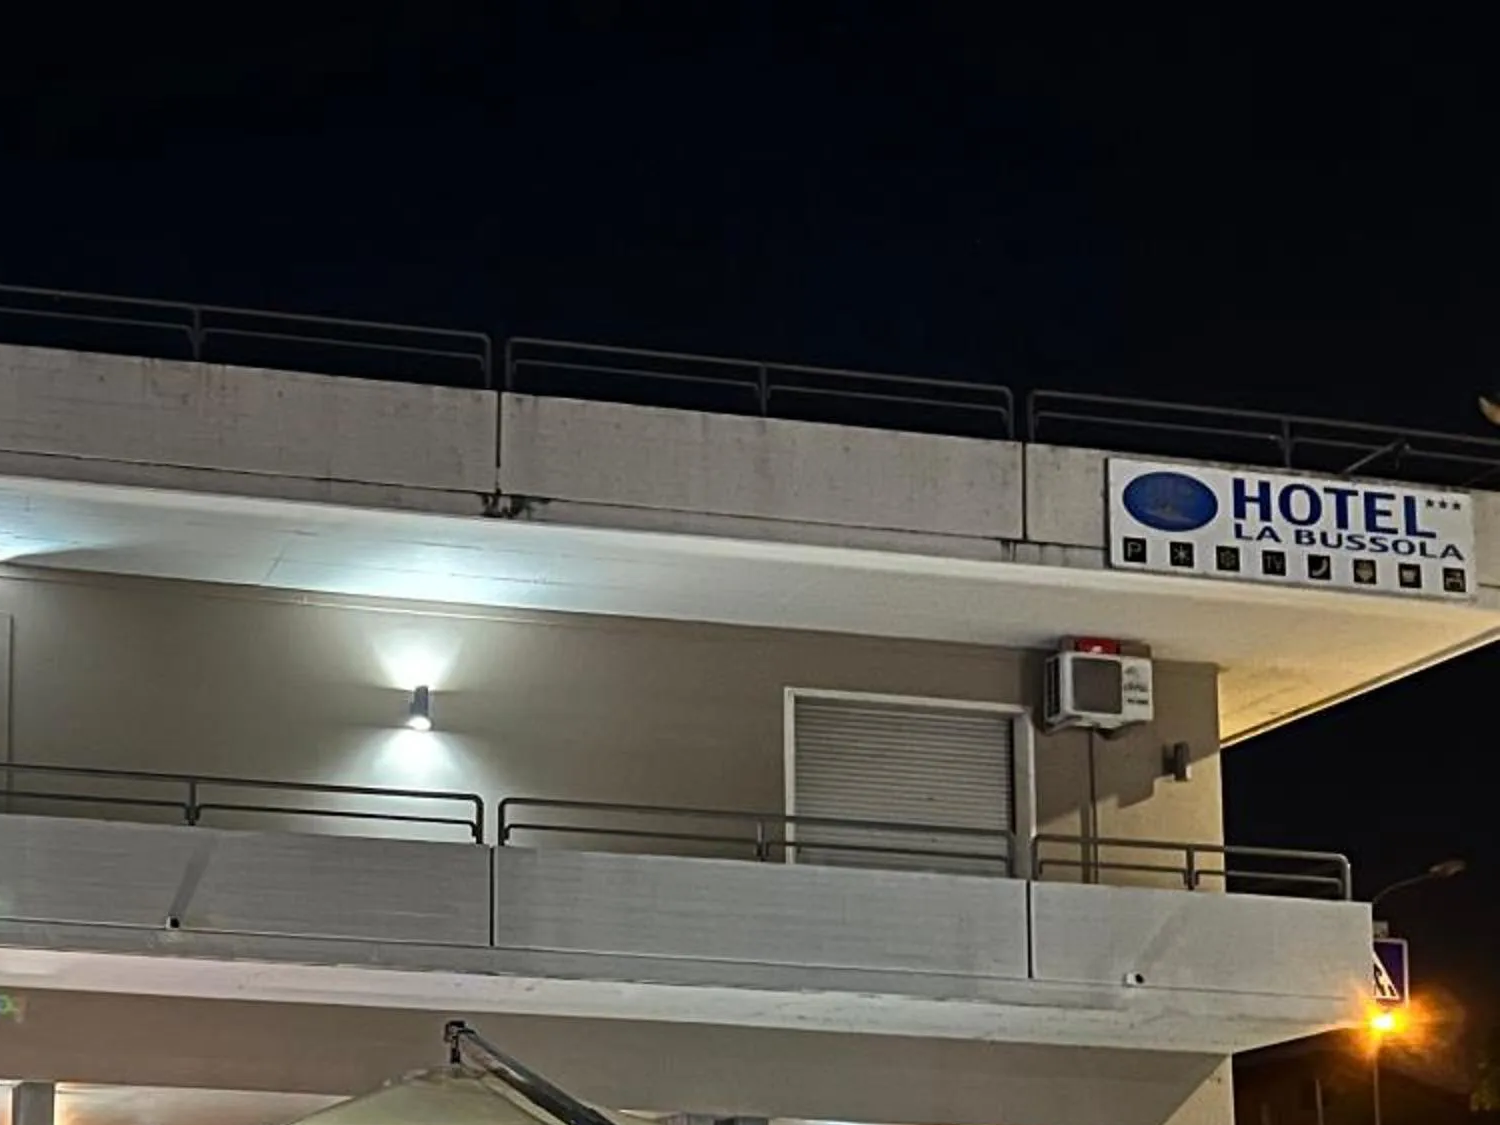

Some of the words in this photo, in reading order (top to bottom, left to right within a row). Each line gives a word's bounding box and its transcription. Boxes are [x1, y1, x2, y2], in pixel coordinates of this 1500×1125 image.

[1232, 477, 1437, 539] HOTEL
[1234, 523, 1282, 543] LA
[1294, 528, 1466, 562] BUSSOLA
